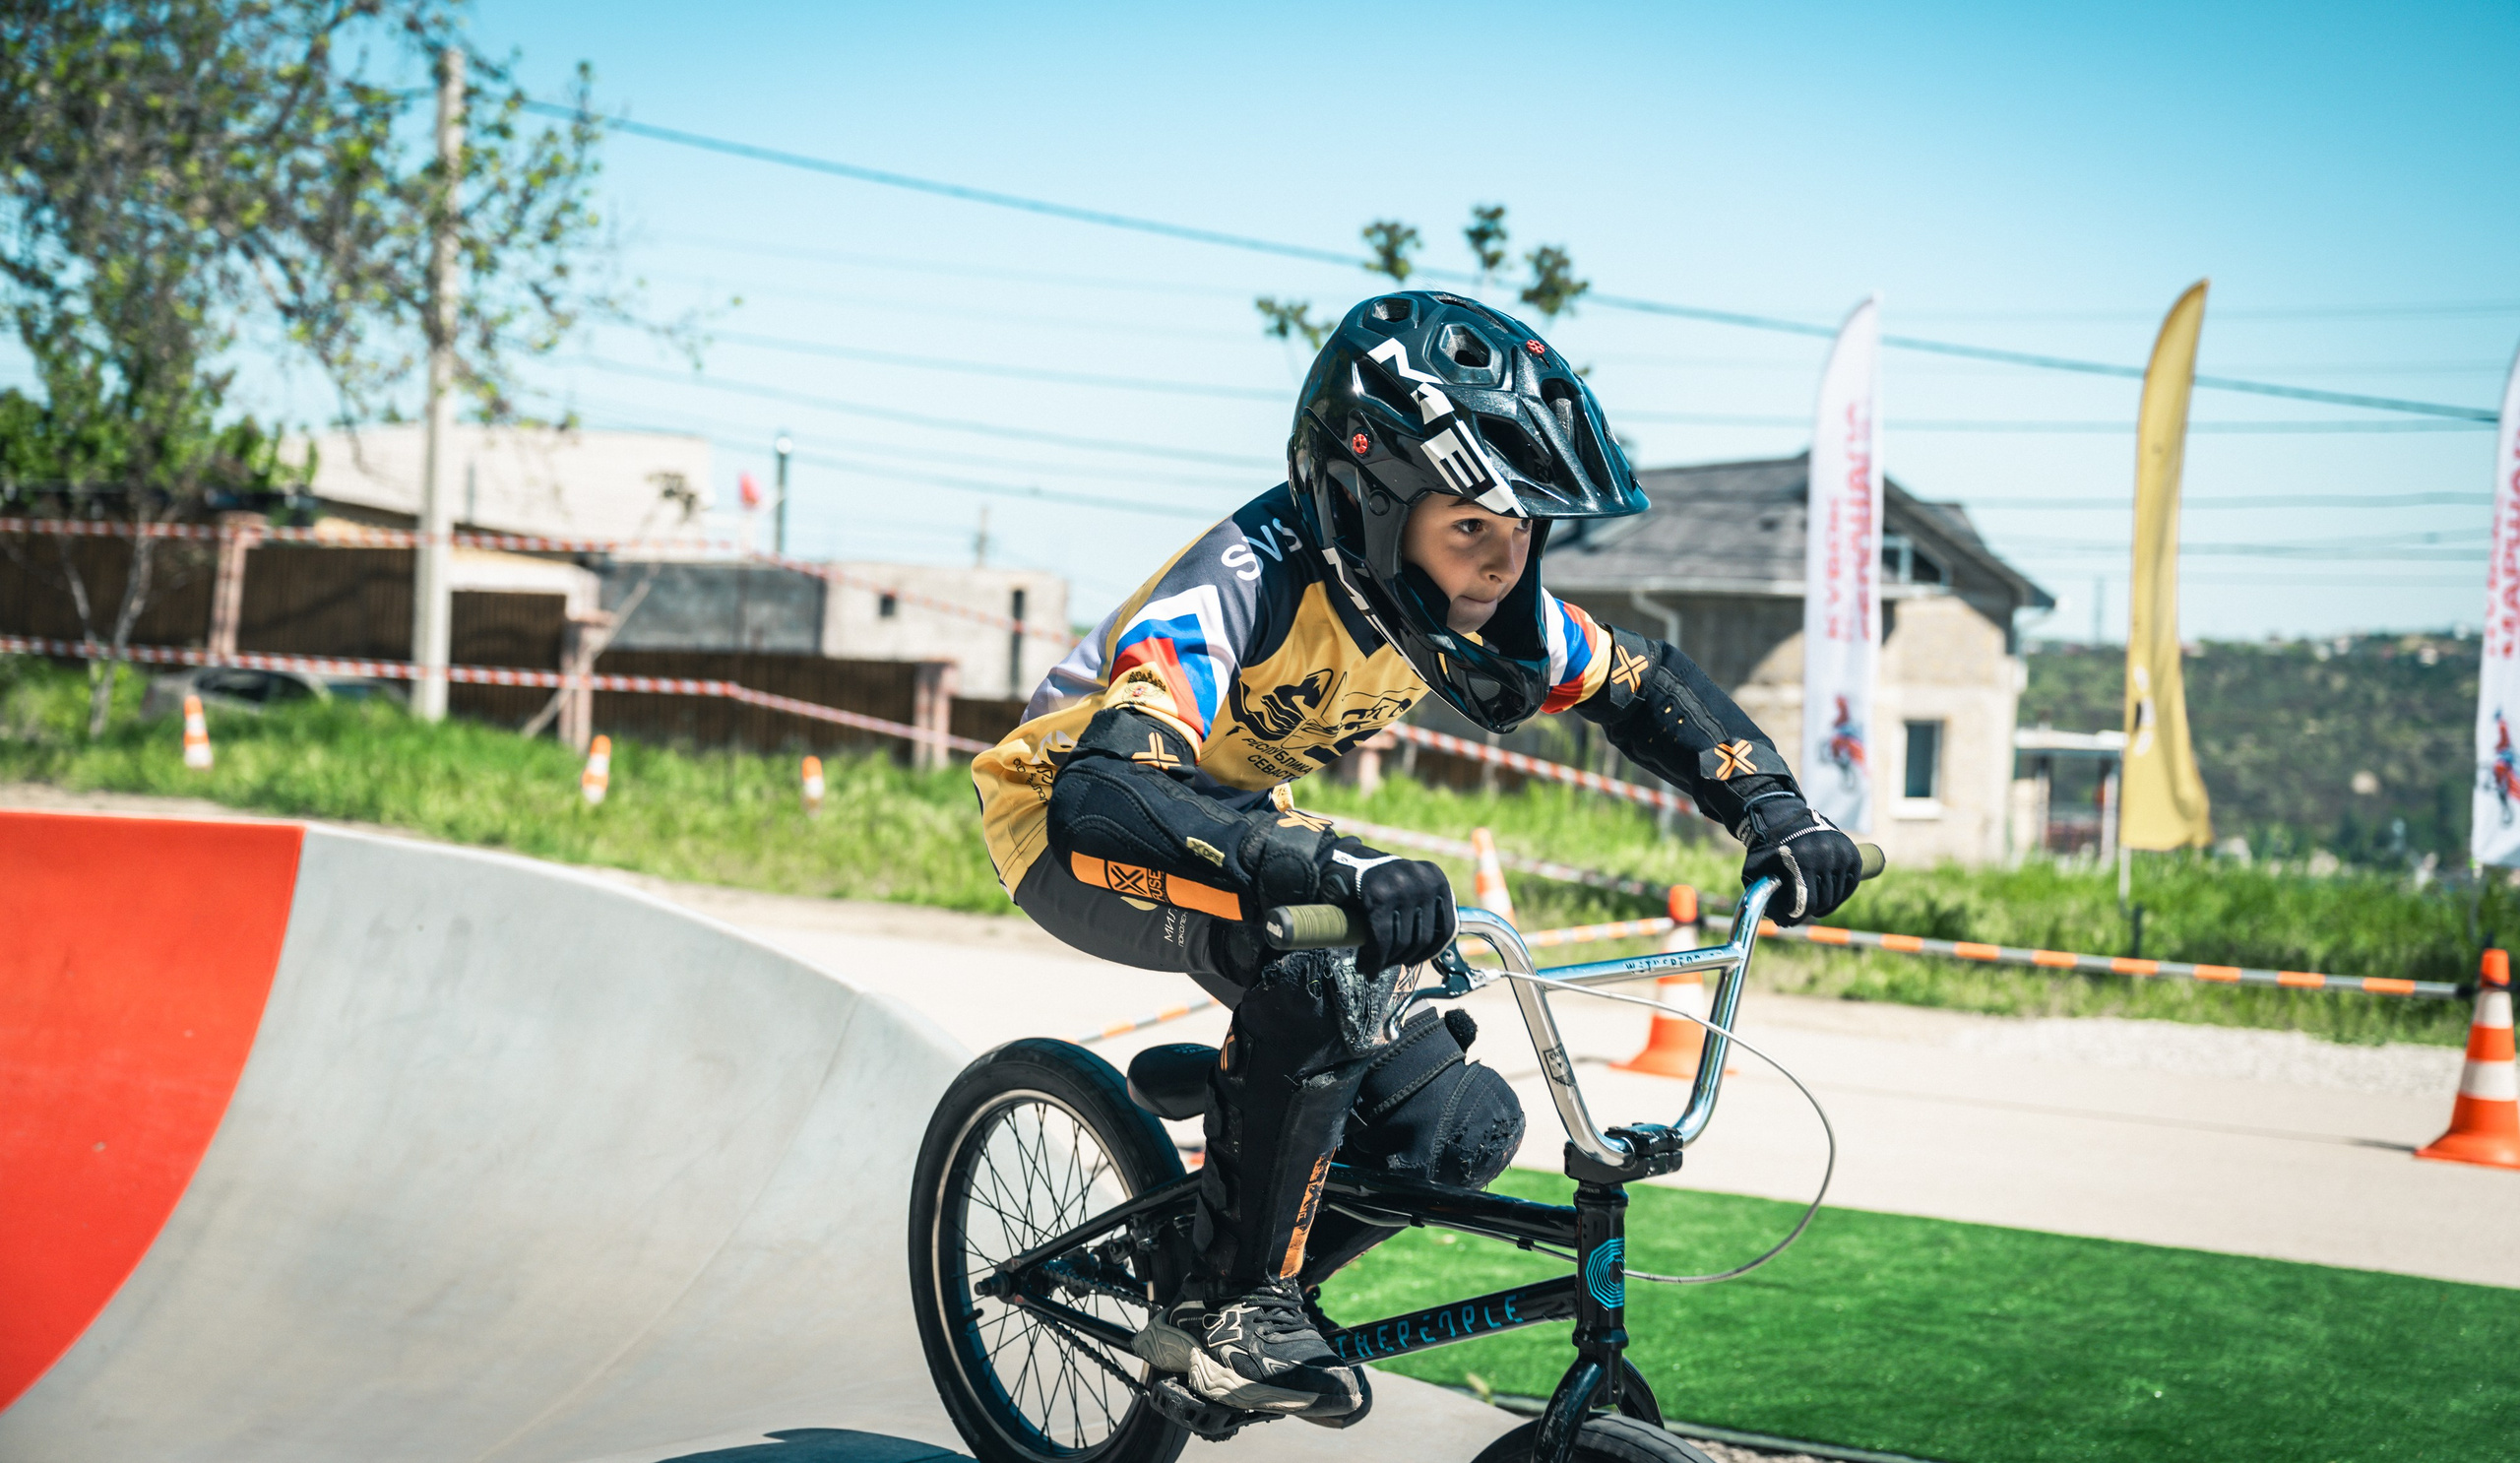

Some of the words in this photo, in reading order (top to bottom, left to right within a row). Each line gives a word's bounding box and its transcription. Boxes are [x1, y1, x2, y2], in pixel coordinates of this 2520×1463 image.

[1241, 737, 1314, 775] РЕСПУБЛИКА
[1149, 869, 1165, 903] FUSE
[1335, 1295, 1524, 1359] THEPEOPLE
